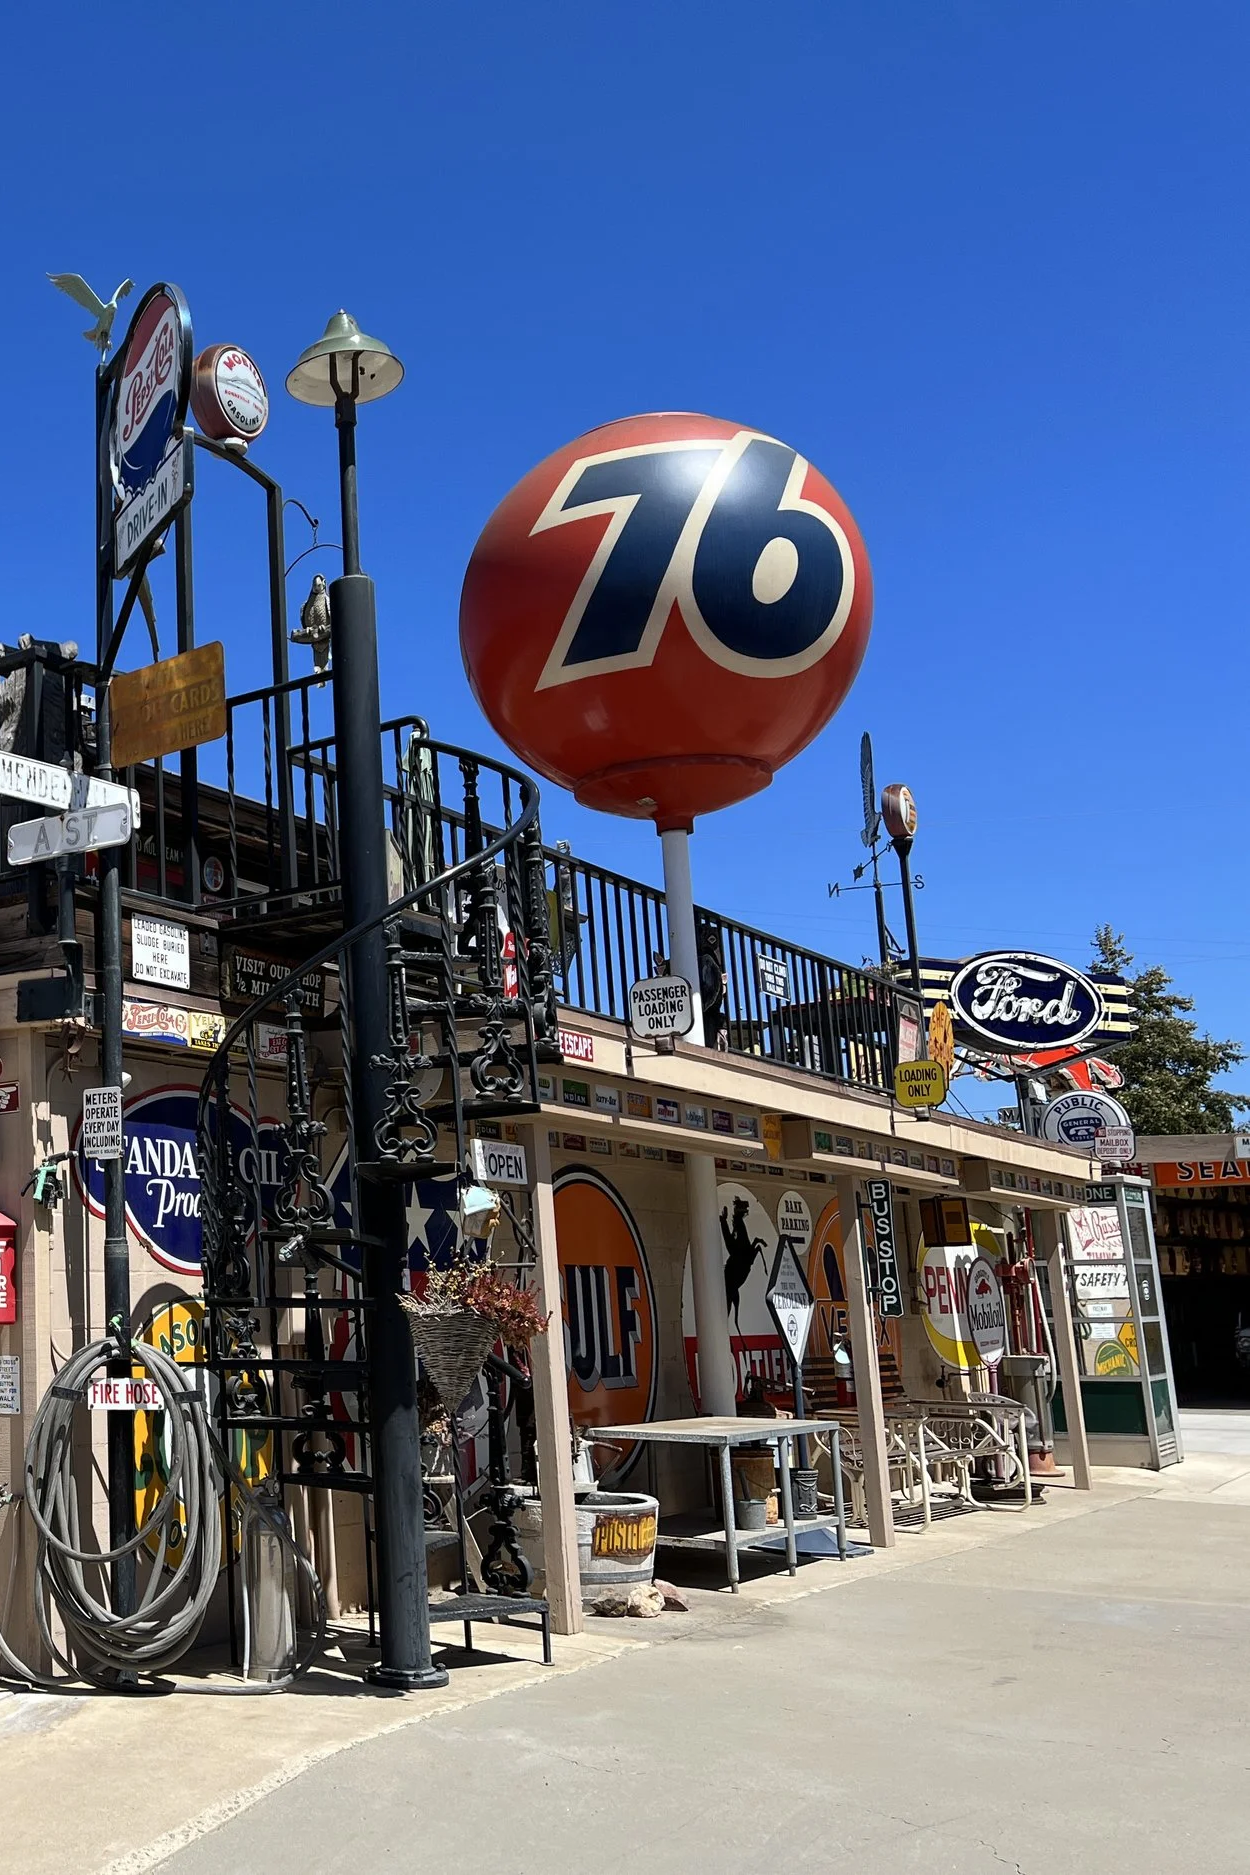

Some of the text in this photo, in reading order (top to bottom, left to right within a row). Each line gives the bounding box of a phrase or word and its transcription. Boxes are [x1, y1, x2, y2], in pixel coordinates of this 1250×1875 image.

[127, 478, 168, 549] DRIVE-IN
[528, 431, 855, 692] 76
[170, 684, 222, 712] CARDS
[152, 952, 168, 965] HERE
[633, 985, 687, 1003] PASSENGER
[971, 961, 1082, 1026] Ford
[638, 1001, 683, 1016] LOADING
[648, 1015, 676, 1030] ONLY
[565, 1034, 593, 1060] ESCAPE
[899, 1068, 937, 1083] LOADING
[85, 1092, 118, 1105] METERS
[908, 1084, 931, 1098] ONLY
[1053, 1096, 1104, 1115] PUBLIC
[85, 1107, 119, 1120] OPERATE
[84, 1120, 119, 1134] EVERY DAY
[1062, 1118, 1100, 1128] GENERAL
[84, 1135, 120, 1148] INCLUDING
[1099, 1139, 1129, 1147] MAILBOX
[488, 1152, 524, 1180] OPEN
[784, 1200, 803, 1214] BANK
[780, 1217, 810, 1232] PARKING
[1080, 1273, 1120, 1287] SAFETY
[92, 1383, 159, 1405] FIRE HOSE
